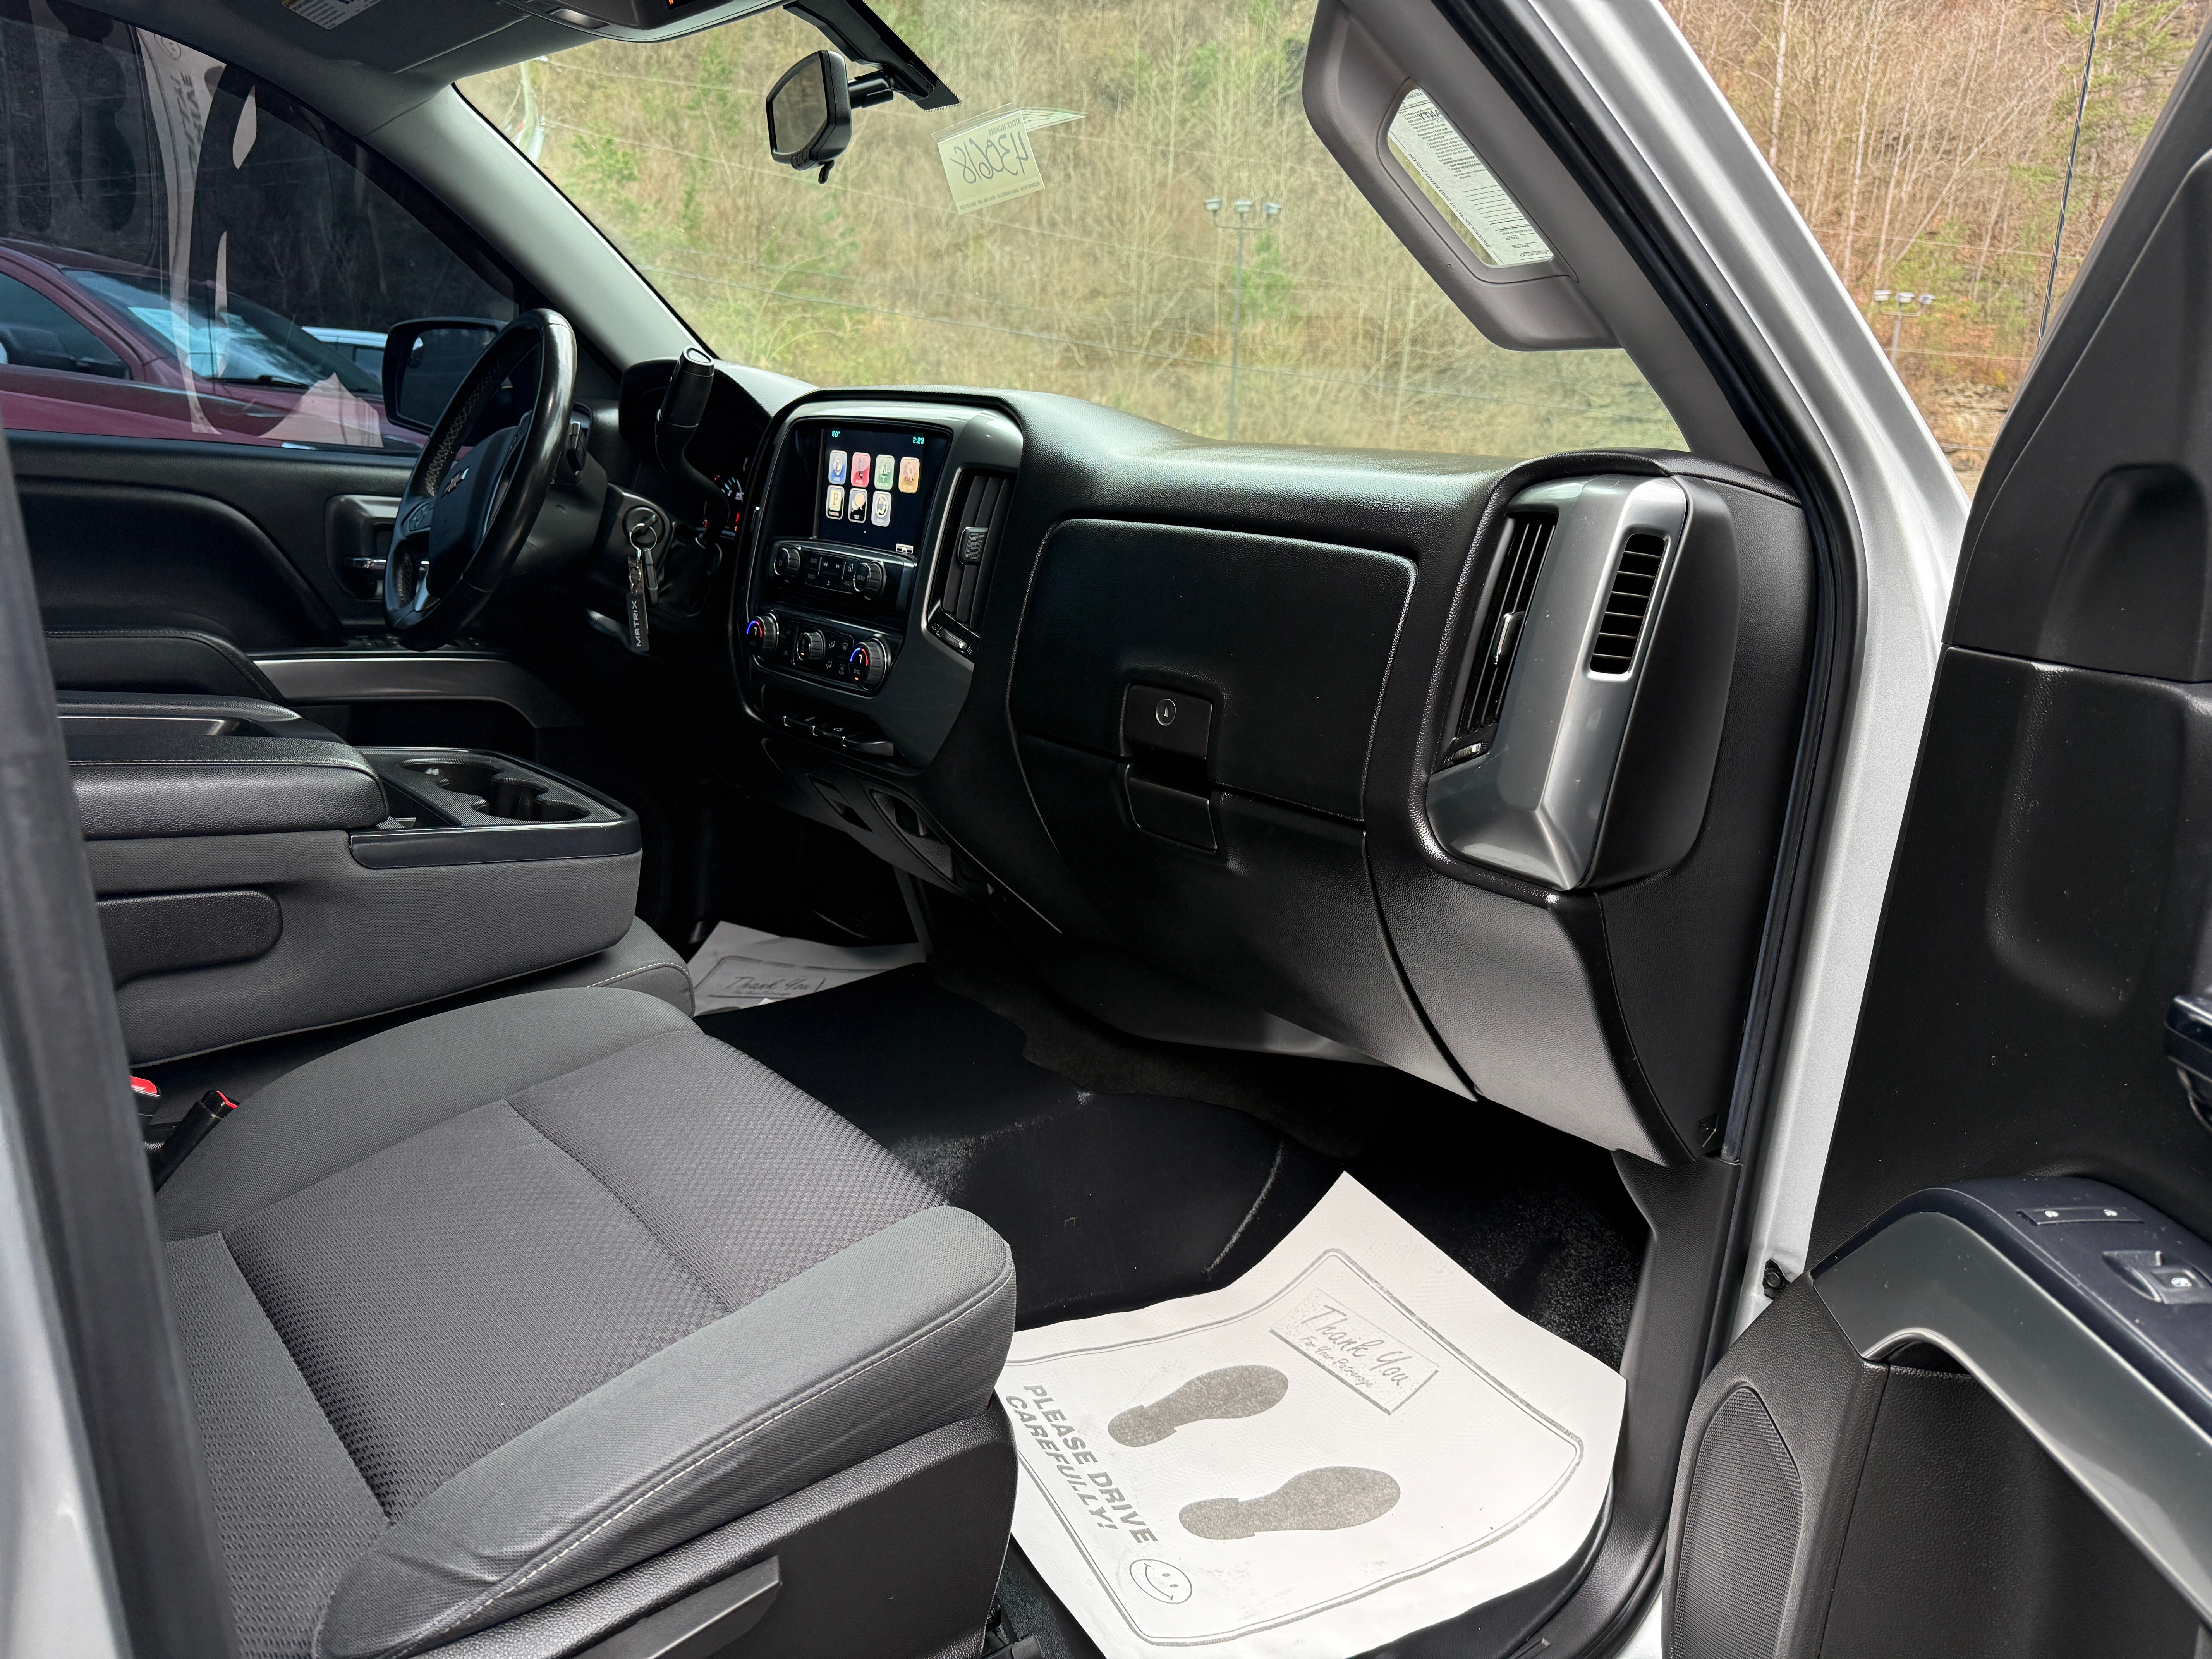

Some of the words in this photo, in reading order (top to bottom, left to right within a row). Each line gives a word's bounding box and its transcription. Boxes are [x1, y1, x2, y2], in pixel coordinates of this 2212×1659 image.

[1355, 500, 1413, 513] AIRBAG
[631, 600, 642, 647] MATRIX
[726, 976, 785, 990] Thank
[784, 977, 811, 991] You
[1299, 1336, 1317, 1348] For
[1315, 1346, 1335, 1360] Your
[1333, 1357, 1374, 1388] Patronage
[1301, 1305, 1385, 1358] Thank
[1369, 1351, 1413, 1387] You
[1006, 1395, 1118, 1530] CAREFULLY!
[1023, 1384, 1098, 1465] PLEASE
[1087, 1471, 1158, 1544] DRIVE
